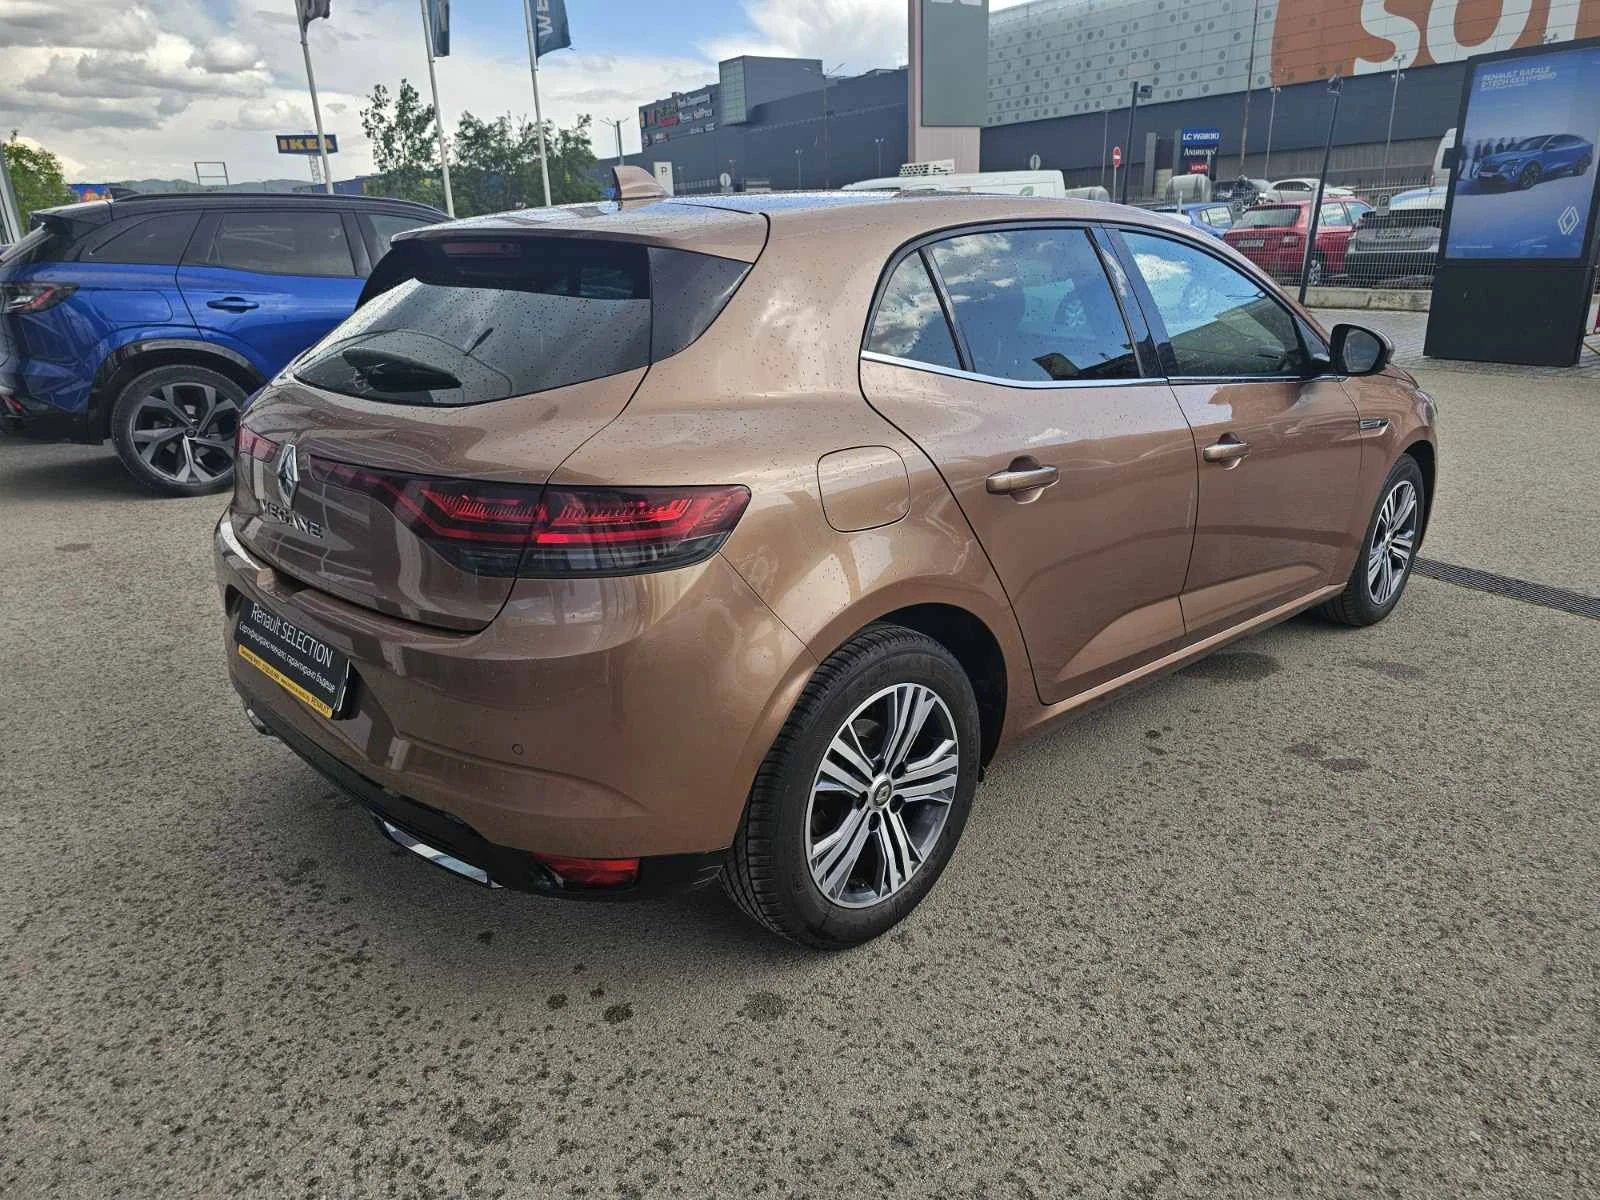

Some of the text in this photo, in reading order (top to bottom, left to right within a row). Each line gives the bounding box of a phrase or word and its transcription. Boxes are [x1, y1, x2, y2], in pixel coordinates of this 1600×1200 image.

[280, 138, 335, 150] IKEA
[251, 602, 334, 668] Renault SELECTION
